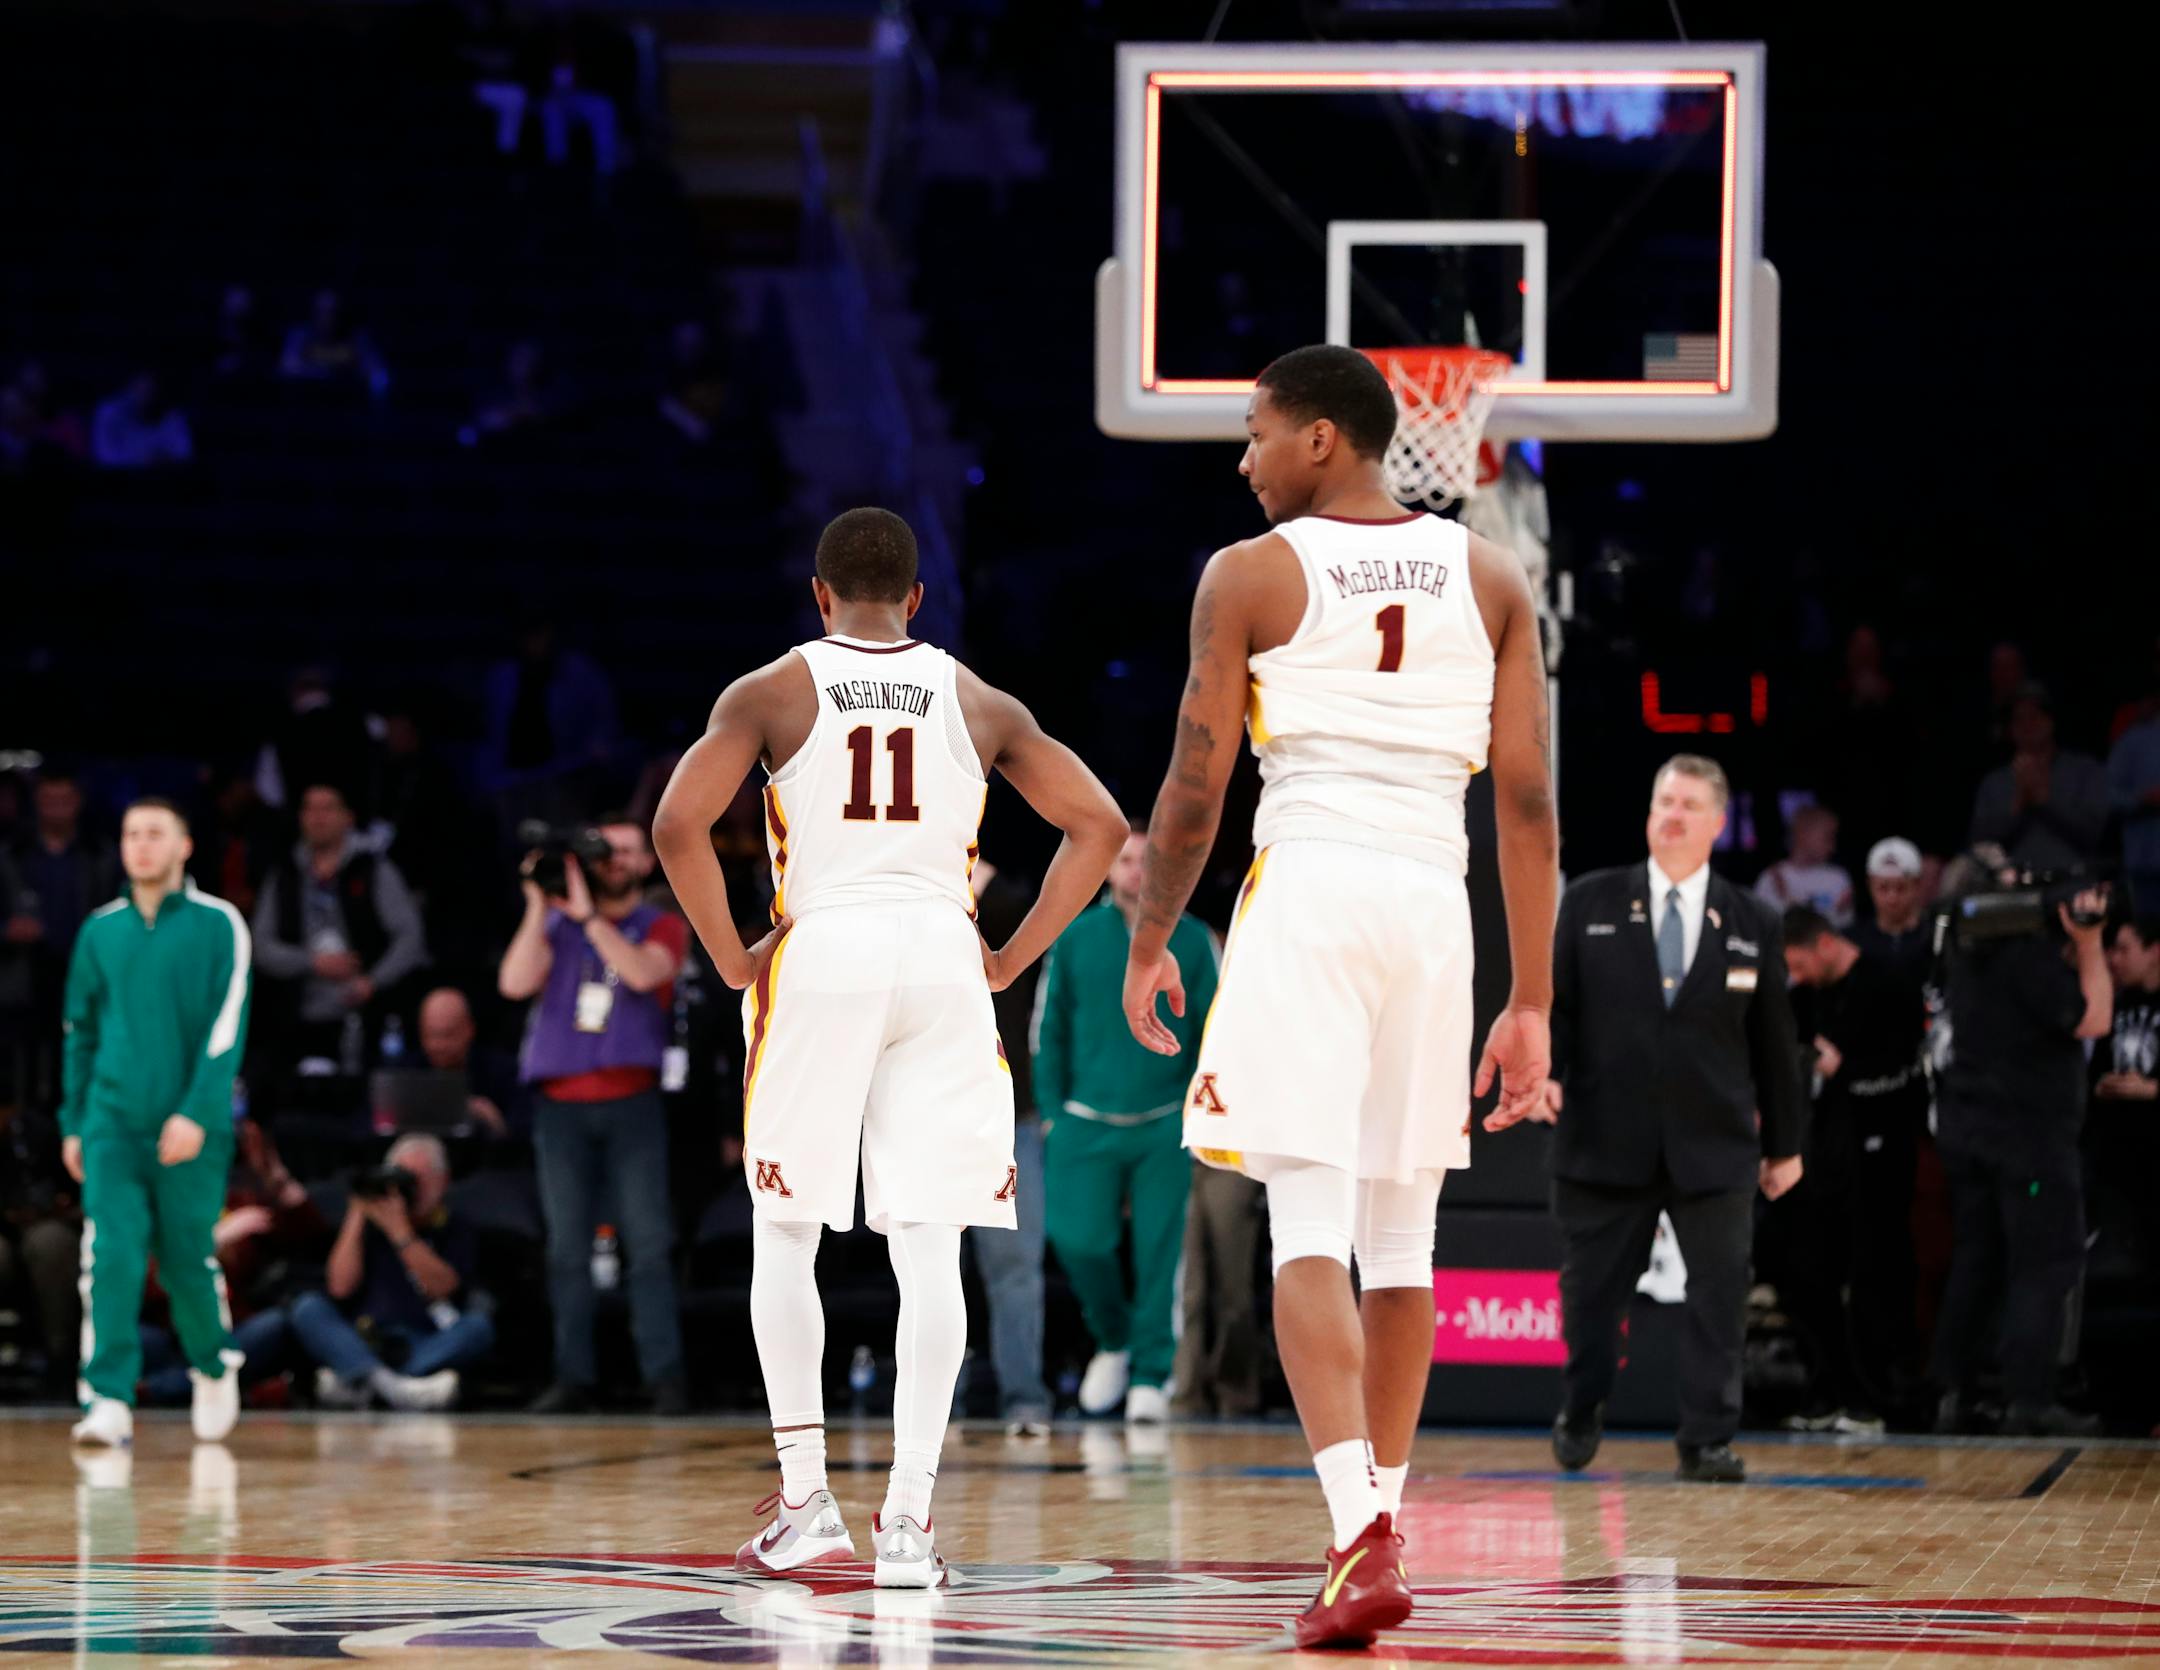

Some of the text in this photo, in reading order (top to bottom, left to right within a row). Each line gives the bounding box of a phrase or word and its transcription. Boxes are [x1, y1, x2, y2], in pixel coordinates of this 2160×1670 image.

[1327, 560, 1449, 598] McBRAYER
[1375, 604, 1405, 672] 1
[826, 680, 935, 718] WASHINGTON
[843, 725, 920, 822] 11
